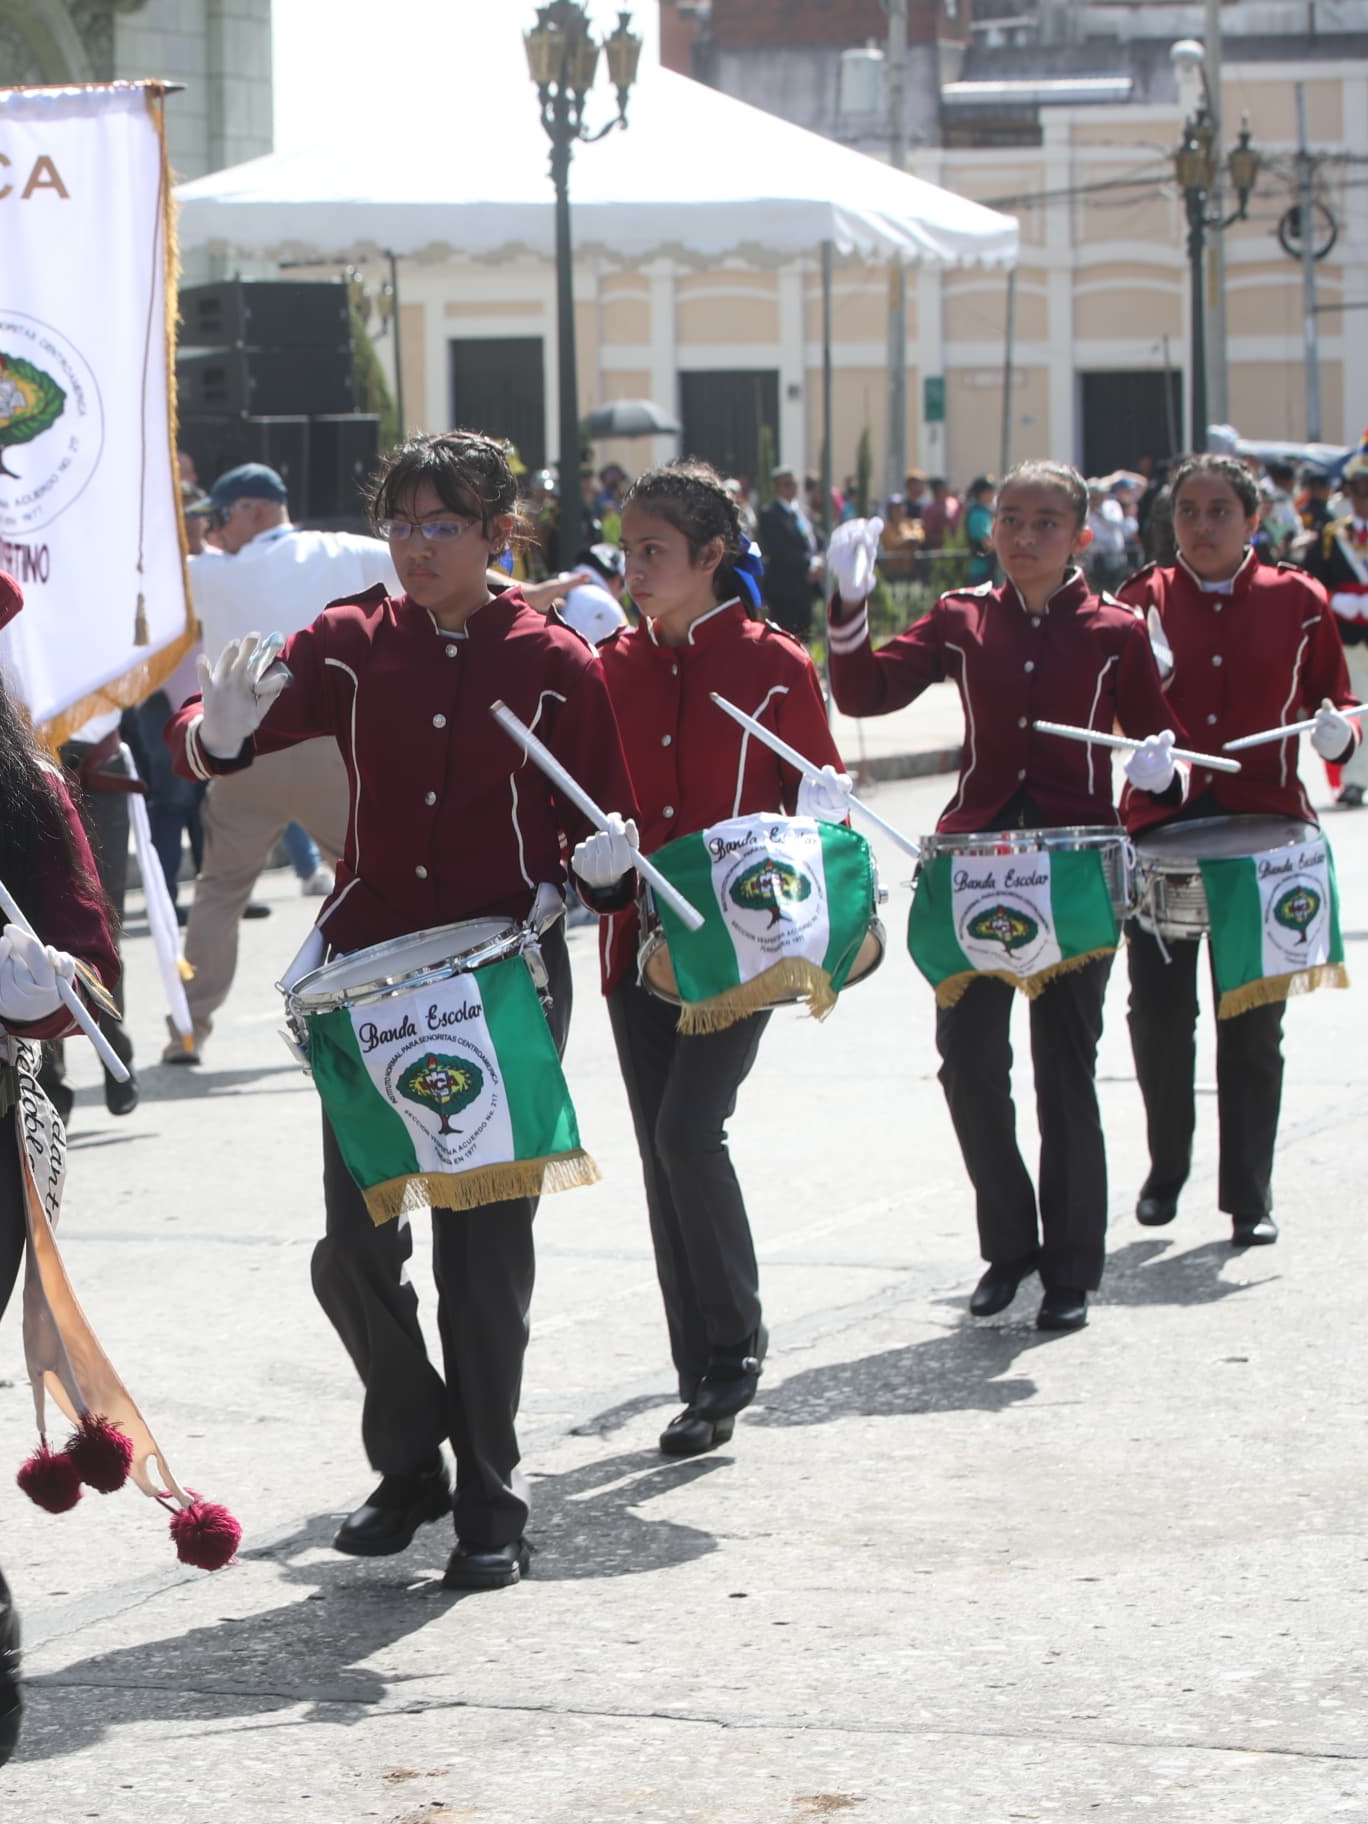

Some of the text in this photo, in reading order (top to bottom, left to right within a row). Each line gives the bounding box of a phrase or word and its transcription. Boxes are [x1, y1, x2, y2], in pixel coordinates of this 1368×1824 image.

[709, 830, 757, 864] Banda
[954, 868, 1048, 893] Banda Escolar
[359, 1000, 482, 1054] Banda Escolar
[457, 1037, 499, 1086] CENTROAMERICA
[458, 1121, 488, 1152] ACUERDO
